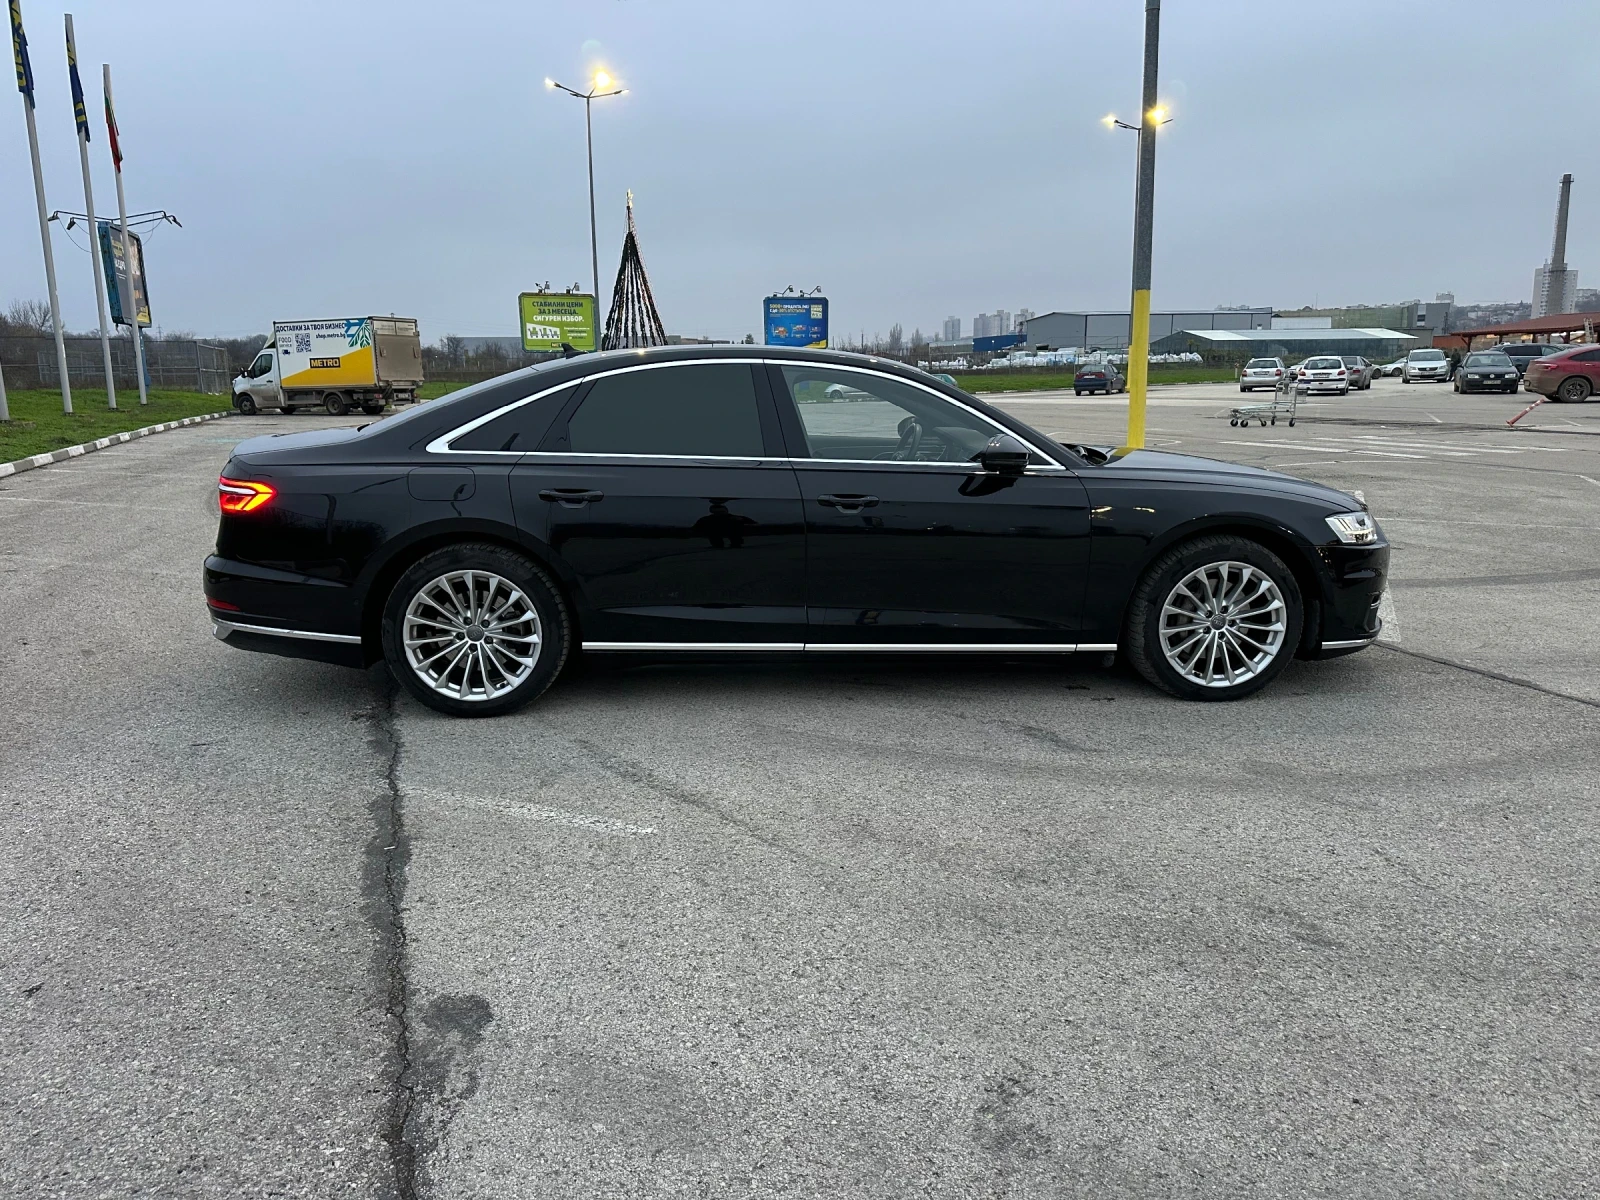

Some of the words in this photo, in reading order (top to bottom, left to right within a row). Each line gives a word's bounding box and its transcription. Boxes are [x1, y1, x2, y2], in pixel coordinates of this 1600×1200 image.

[566, 301, 583, 309] ЦЕНИ
[276, 325, 303, 333] ДОСТАВКИ
[310, 323, 324, 331] ТВОЯ
[325, 322, 345, 330] БИЗНЕС
[311, 359, 339, 367] METRO
